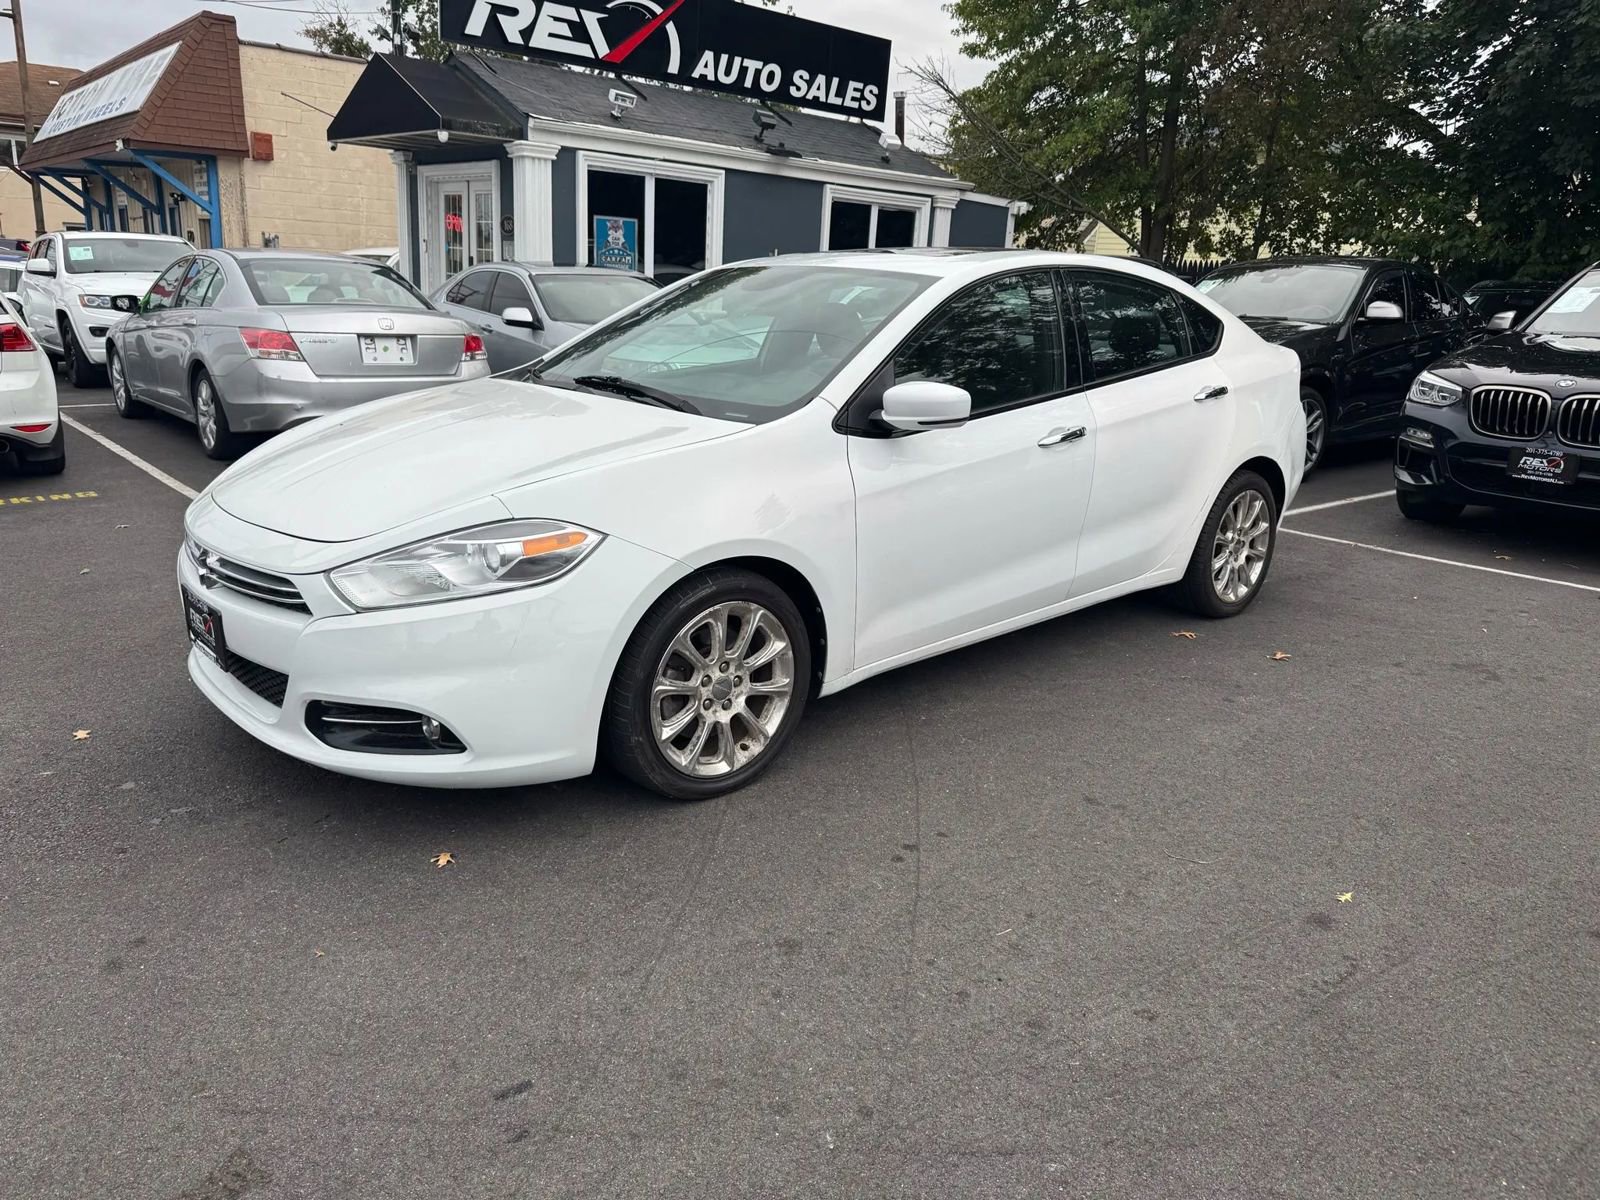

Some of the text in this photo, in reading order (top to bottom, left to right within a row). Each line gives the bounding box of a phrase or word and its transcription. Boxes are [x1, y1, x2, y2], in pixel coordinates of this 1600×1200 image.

[692, 50, 878, 112] AUTO SALES
[82, 96, 127, 122] WHEELS
[1517, 463, 1562, 474] MOTORS
